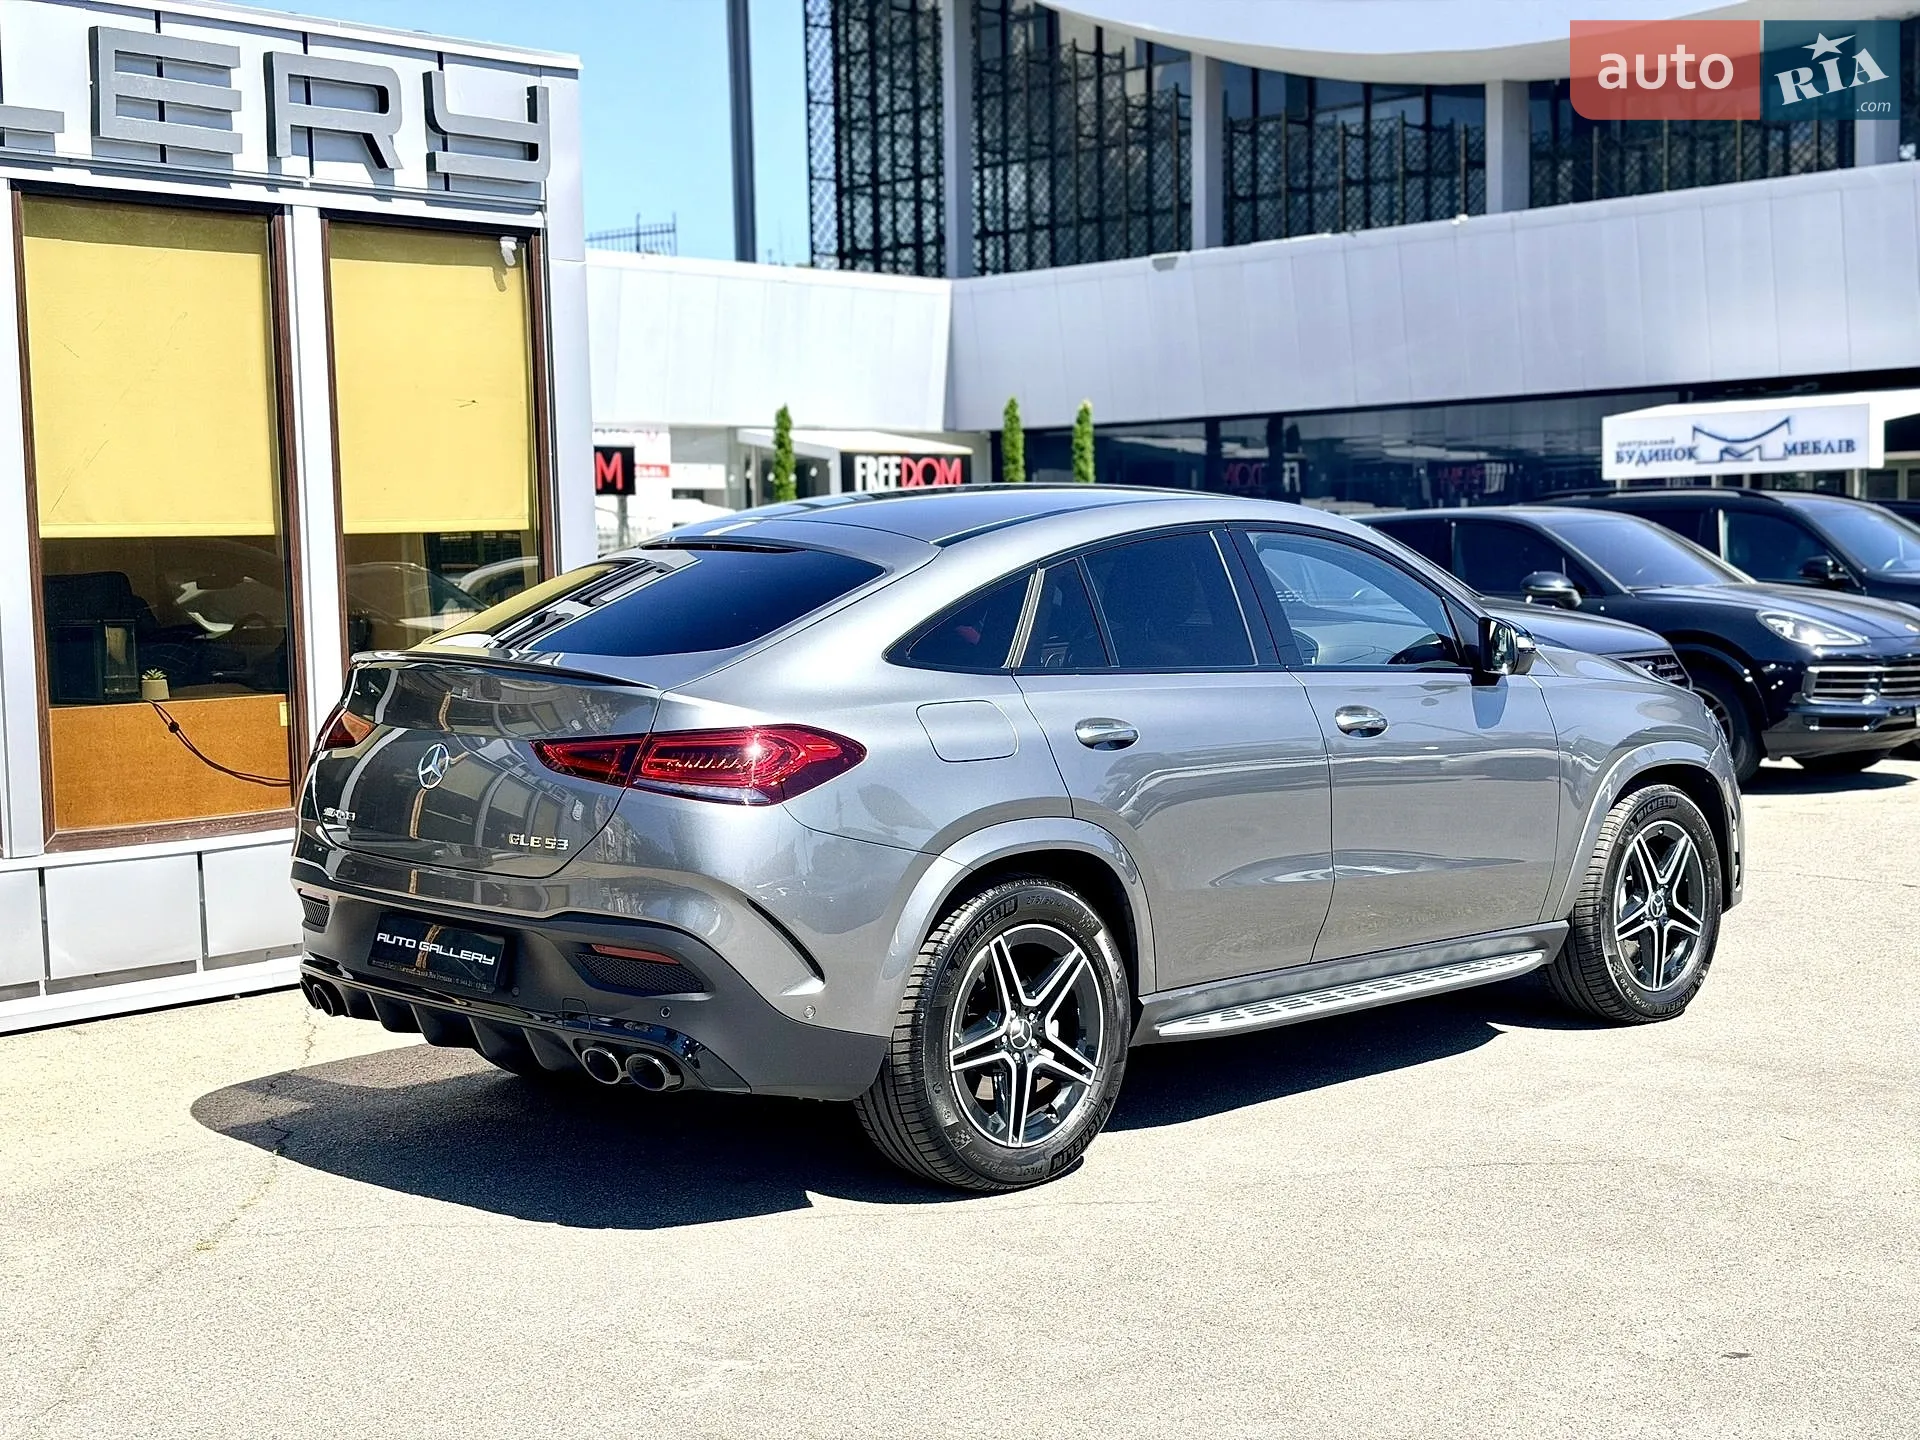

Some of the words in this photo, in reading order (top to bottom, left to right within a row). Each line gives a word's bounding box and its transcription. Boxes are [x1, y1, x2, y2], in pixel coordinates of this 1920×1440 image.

[1615, 446, 1699, 467] БУДИНОК
[1784, 439, 1857, 457] МЕБЛІВ
[854, 455, 962, 492] FREEDOM
[1636, 797, 1678, 822] MICHELIN
[509, 833, 542, 848] GLE
[545, 837, 569, 850] 53
[376, 932, 416, 949] AUTO
[418, 941, 496, 966] GALLERY
[953, 899, 1017, 965] MICHELIN
[1053, 1100, 1110, 1170] MICHELIN
